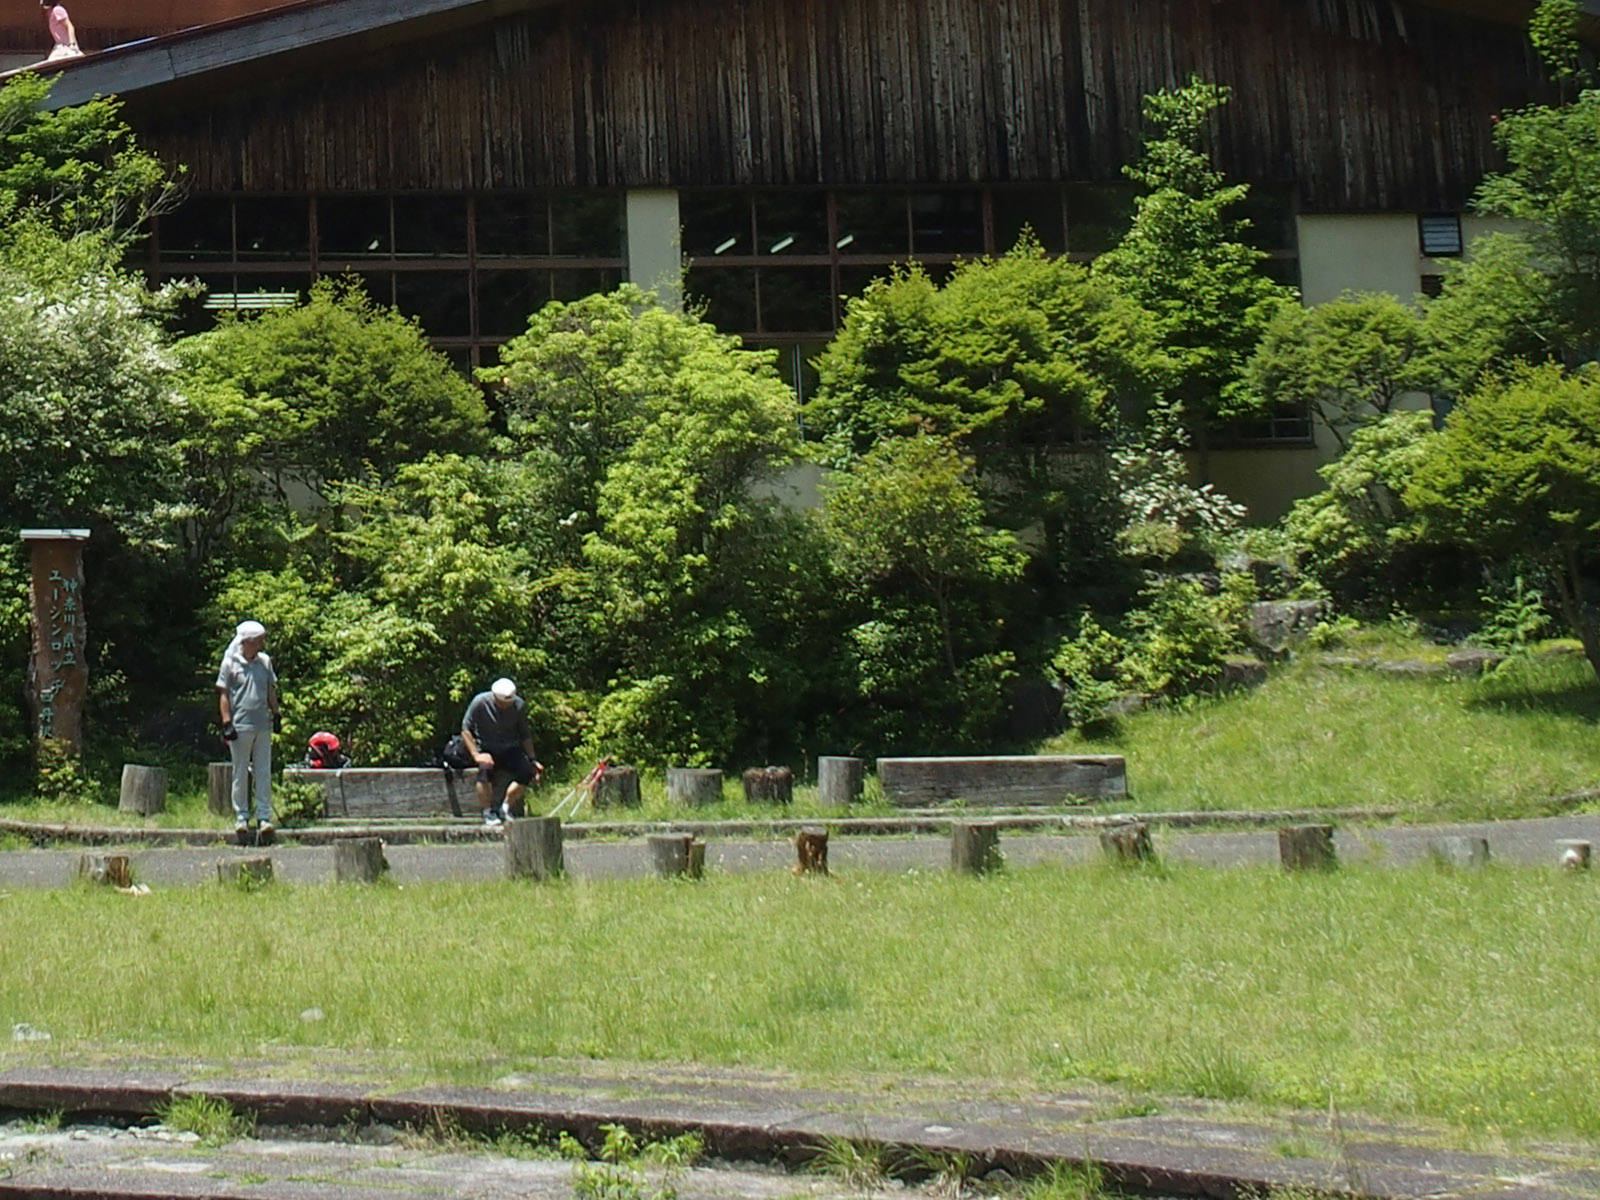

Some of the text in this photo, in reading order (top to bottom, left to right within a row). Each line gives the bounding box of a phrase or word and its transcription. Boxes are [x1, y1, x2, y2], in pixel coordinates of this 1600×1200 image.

[62, 578, 77, 665] 神奈川県立
